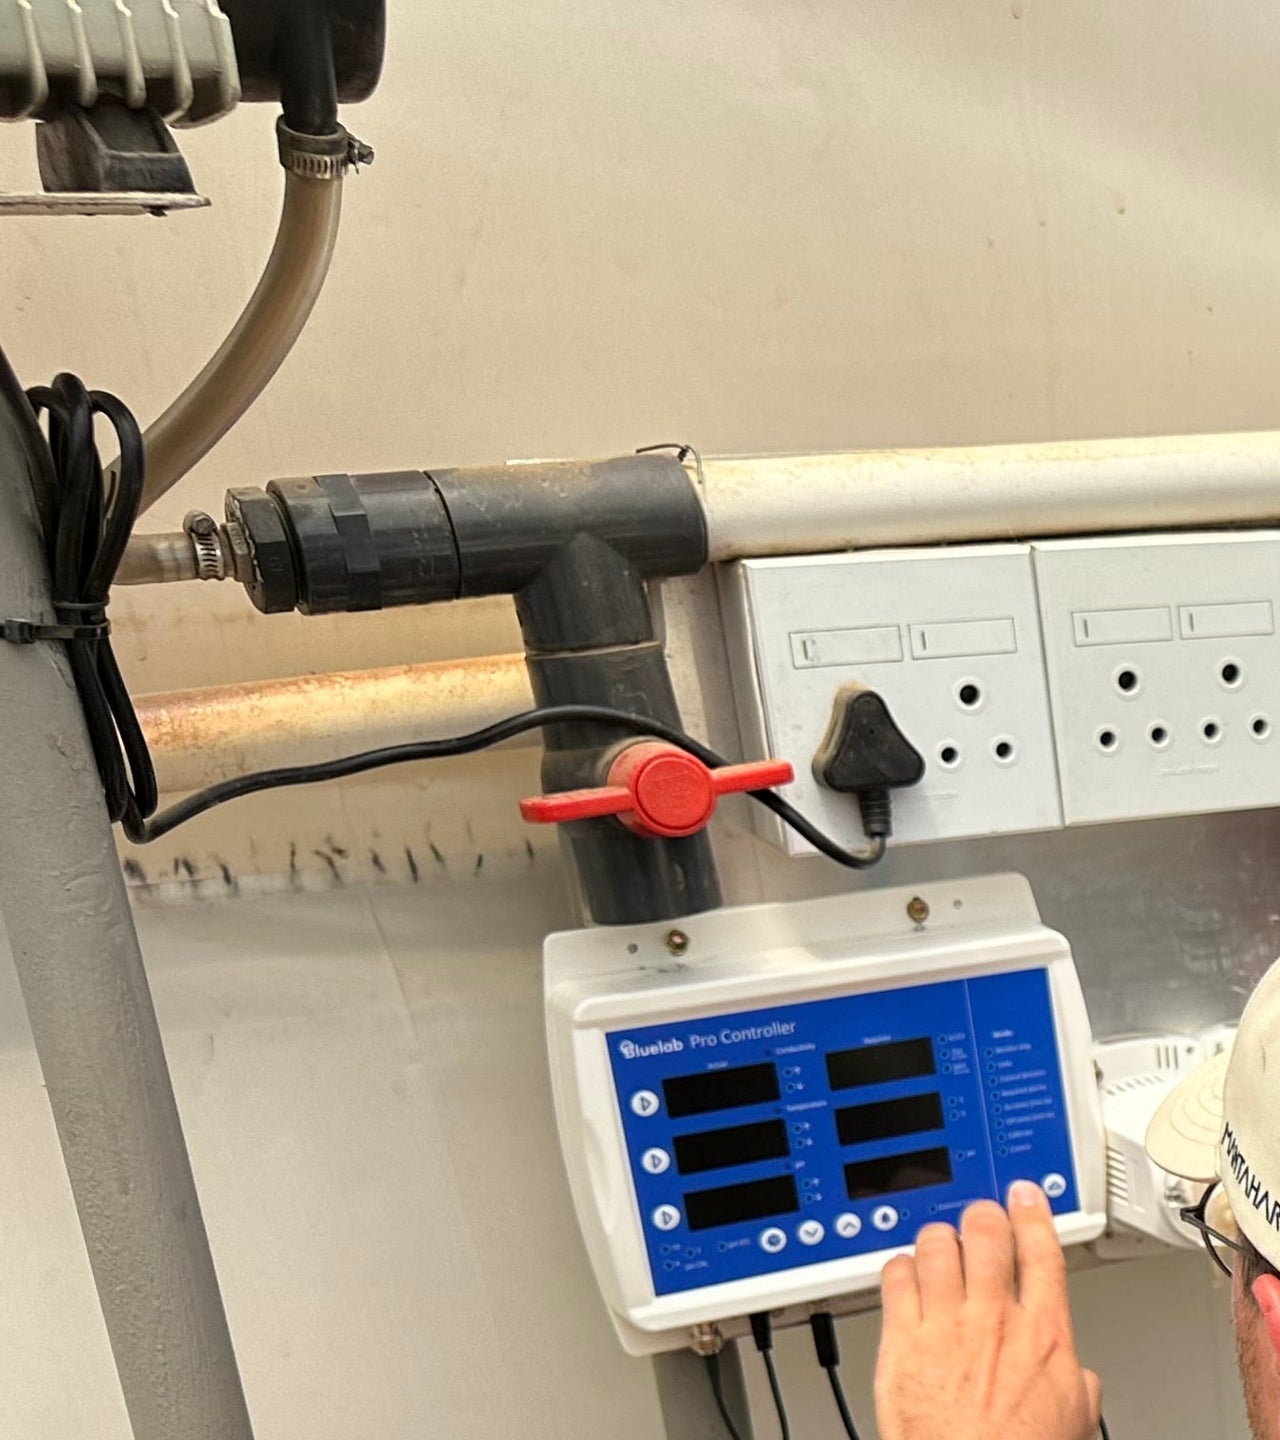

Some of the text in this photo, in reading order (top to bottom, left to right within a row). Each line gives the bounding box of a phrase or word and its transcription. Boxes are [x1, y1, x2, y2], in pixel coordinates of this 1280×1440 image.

[620, 1021, 796, 1060] Bluelab Pro Controller
